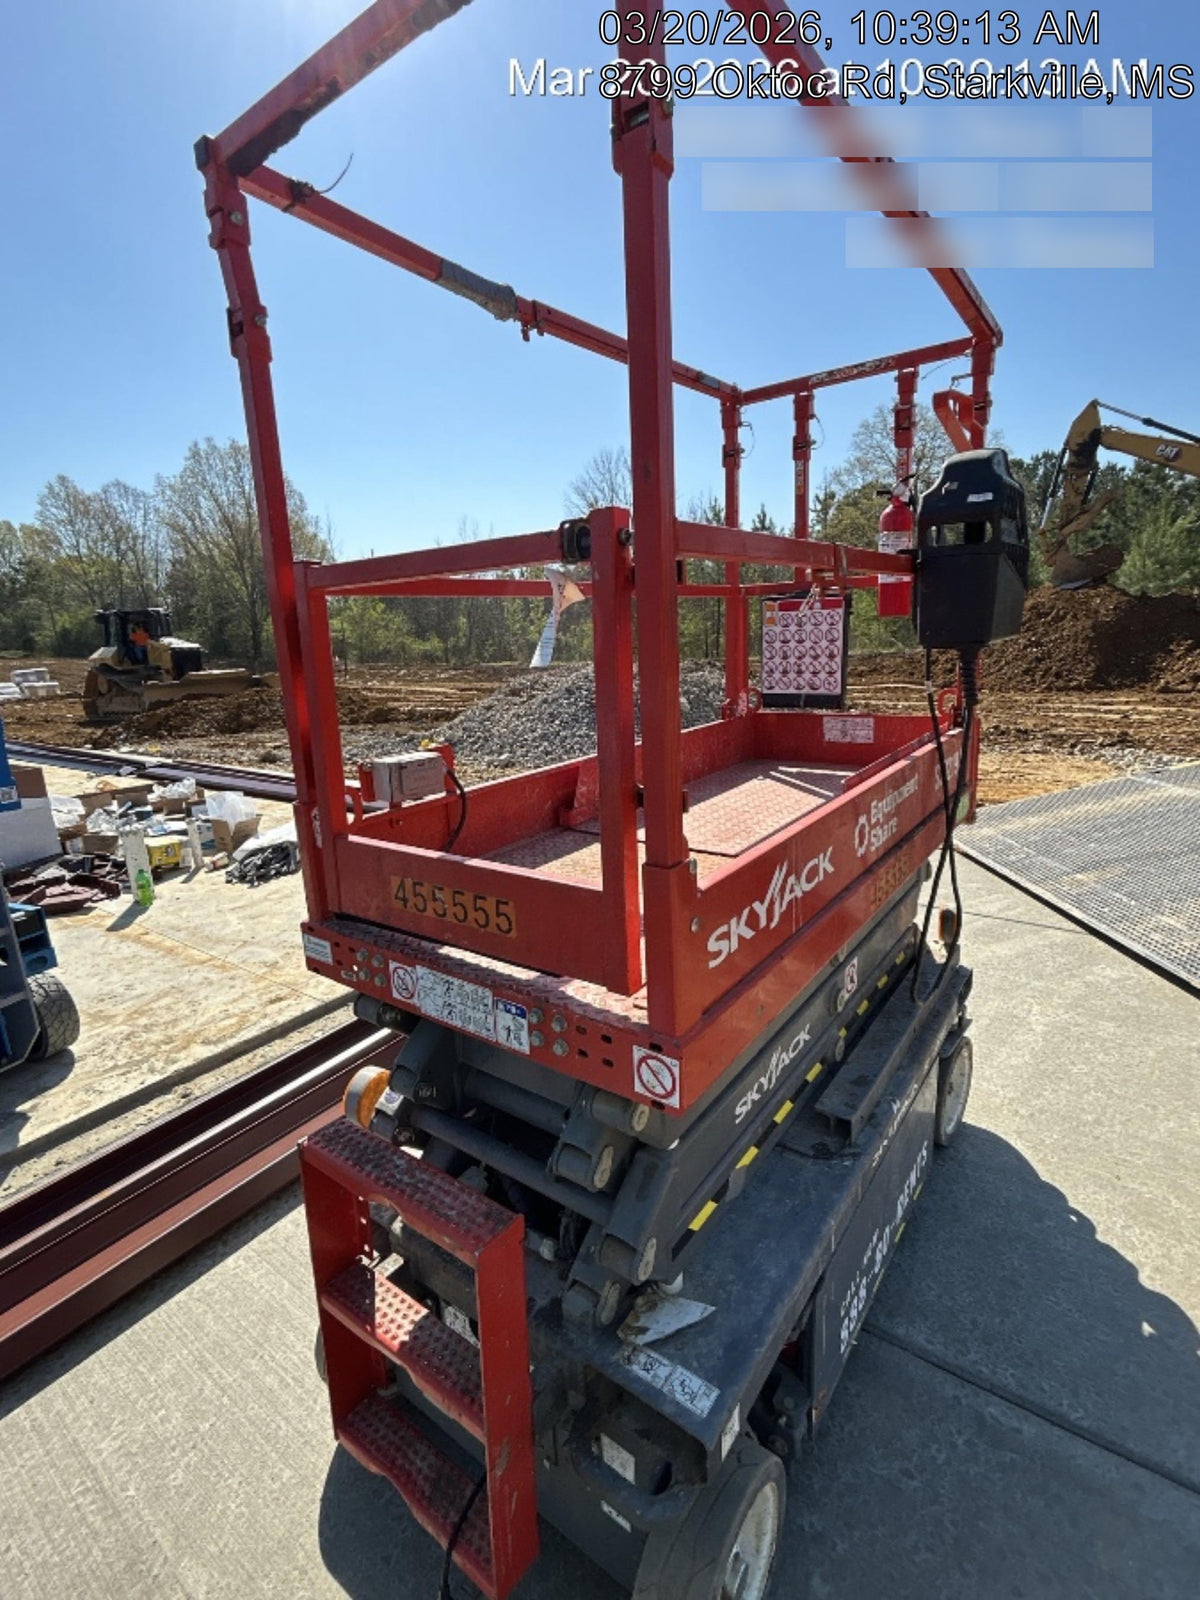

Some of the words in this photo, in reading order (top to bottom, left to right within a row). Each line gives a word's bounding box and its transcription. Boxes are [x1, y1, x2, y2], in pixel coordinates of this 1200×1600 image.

[1155, 444, 1180, 460] CAT
[394, 879, 513, 935] 455555
[707, 846, 835, 969] SKYJACK
[735, 1023, 812, 1124] SKYJACK
